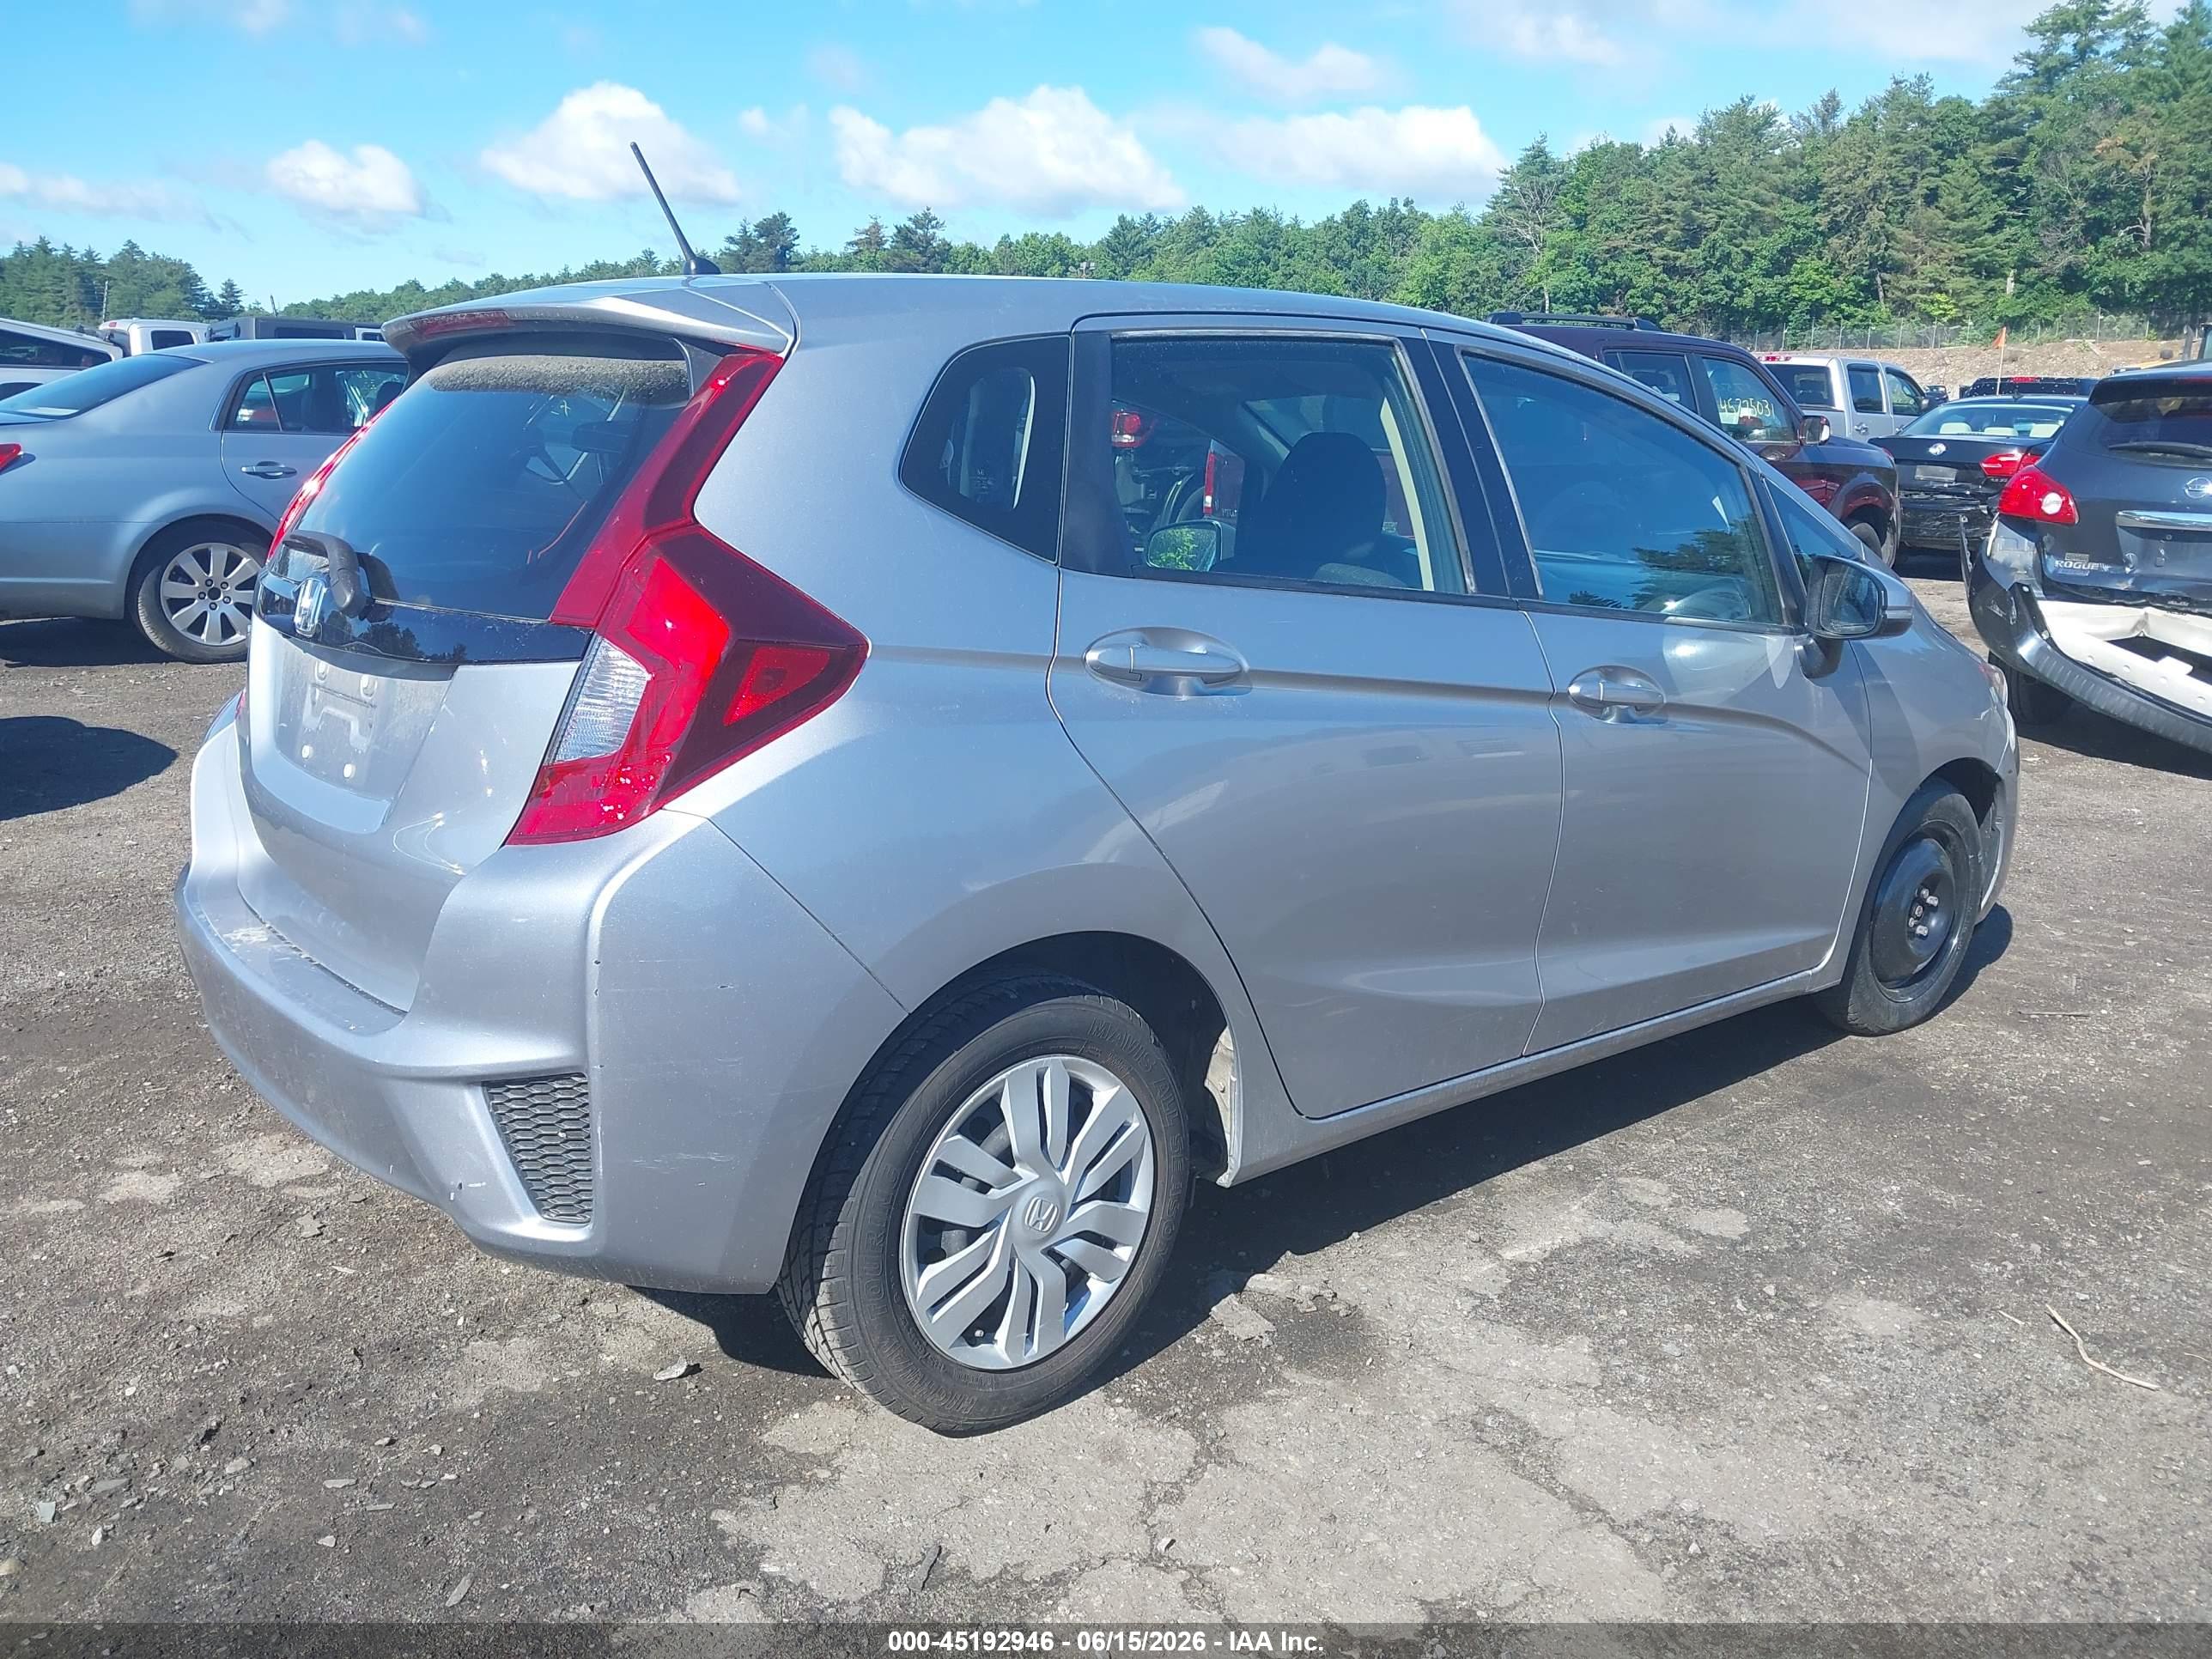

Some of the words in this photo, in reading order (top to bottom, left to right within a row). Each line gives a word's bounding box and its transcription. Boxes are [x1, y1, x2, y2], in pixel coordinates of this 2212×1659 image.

[2054, 560, 2100, 570] ROGUE
[1153, 1078, 1180, 1127] ALL
[864, 1164, 901, 1320] TOURING
